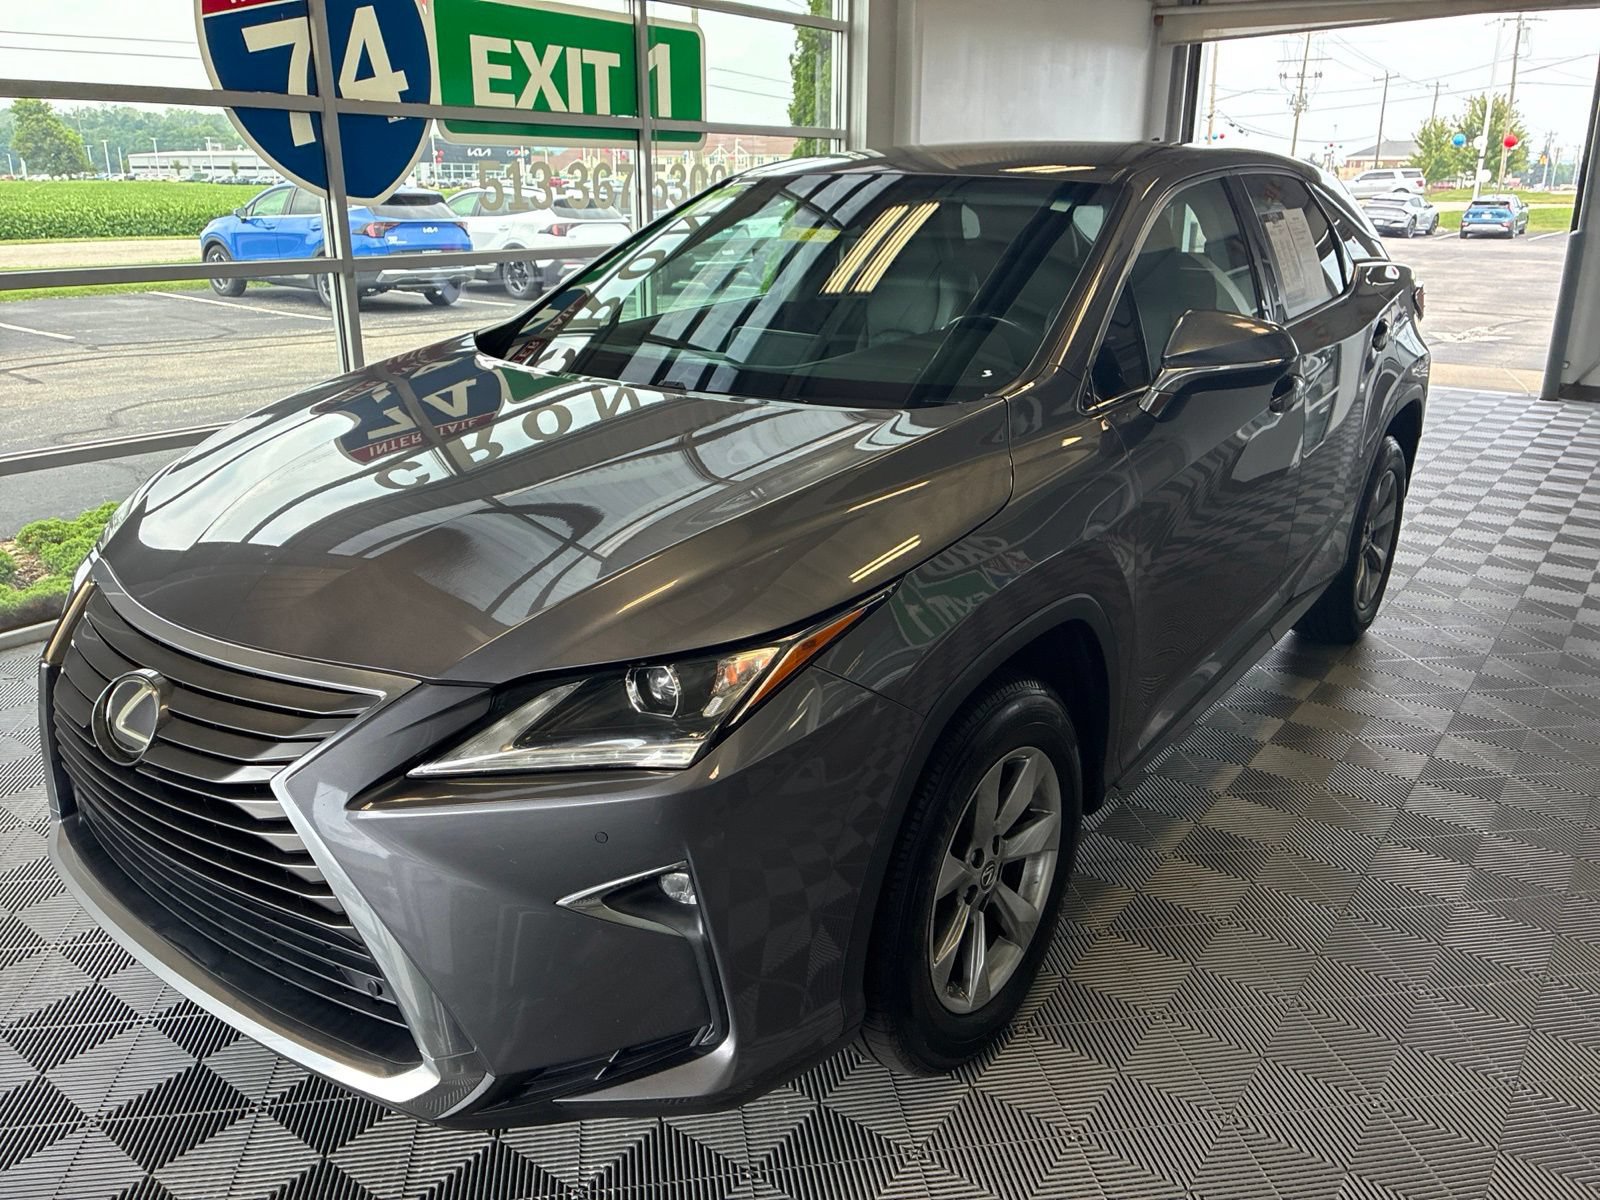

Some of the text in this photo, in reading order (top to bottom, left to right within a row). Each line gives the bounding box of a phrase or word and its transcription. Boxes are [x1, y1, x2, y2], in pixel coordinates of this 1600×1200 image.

[241, 5, 409, 147] 74
[469, 35, 671, 118] EXIT 1
